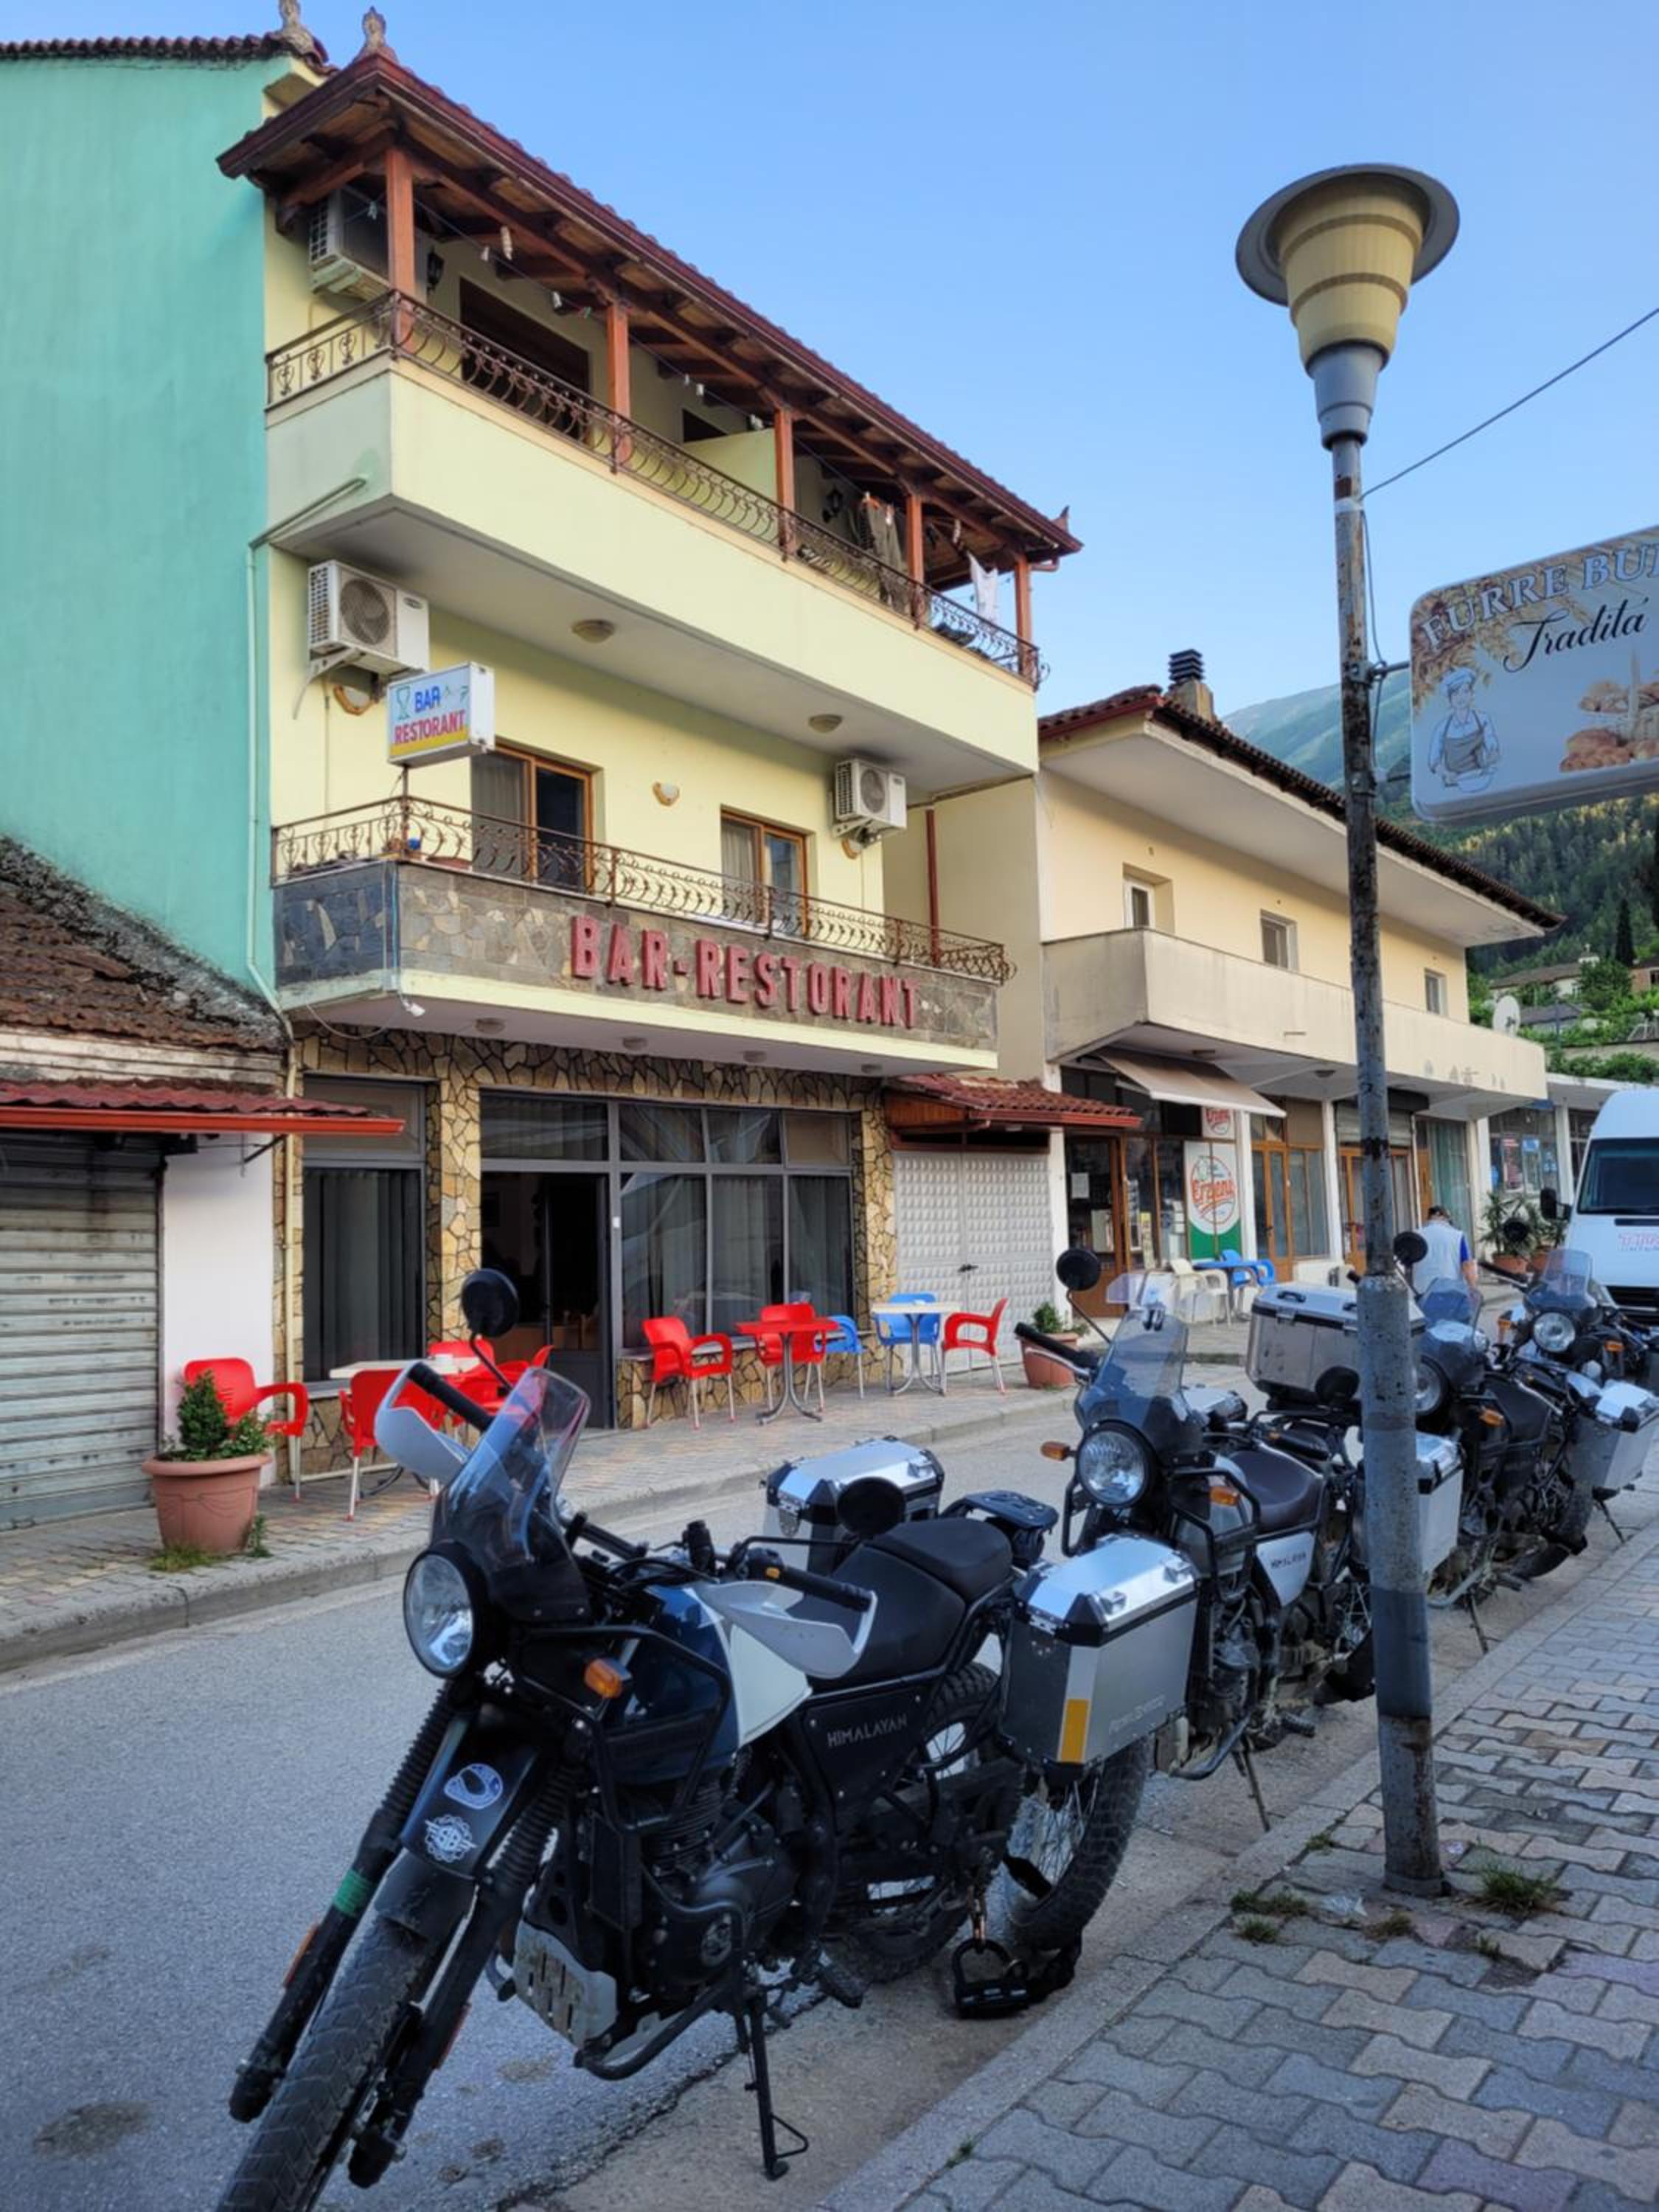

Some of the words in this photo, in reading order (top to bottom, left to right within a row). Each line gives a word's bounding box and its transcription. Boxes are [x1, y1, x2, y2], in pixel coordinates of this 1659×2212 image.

[1420, 565, 1570, 653] FURRE
[414, 686, 441, 713] BAR
[394, 709, 466, 744] RESTORANT
[571, 916, 921, 1029] BAR-RESTORANT
[827, 1712, 908, 1747] HIMALAYAN
